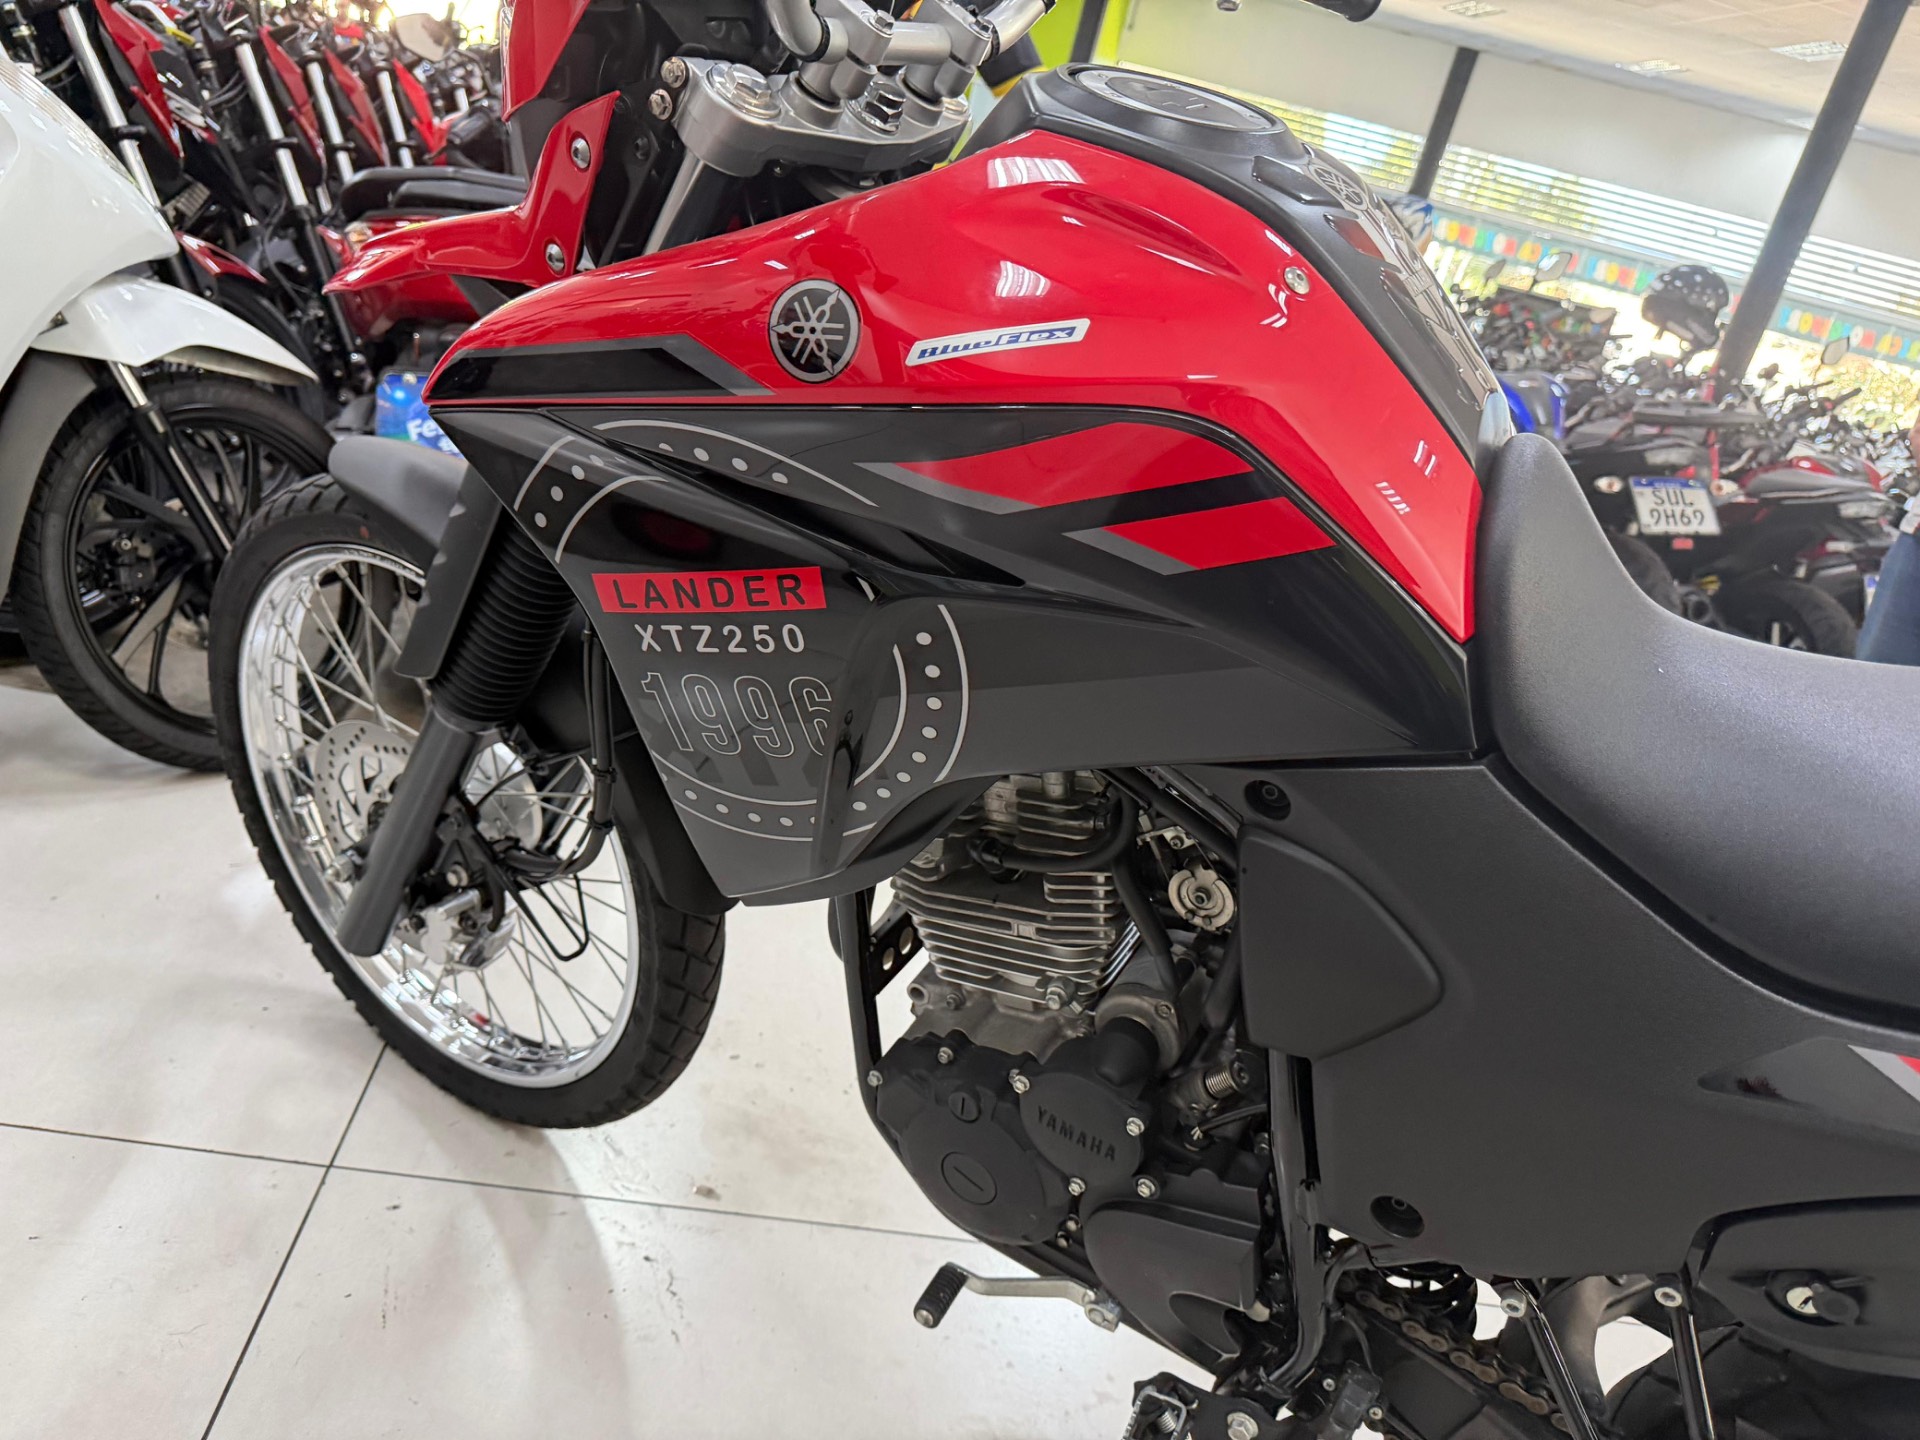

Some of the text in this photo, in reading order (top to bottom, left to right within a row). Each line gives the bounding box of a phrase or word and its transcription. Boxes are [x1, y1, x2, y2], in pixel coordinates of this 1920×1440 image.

[916, 325, 1077, 360] BlueFlex
[1652, 487, 1695, 507] SUL
[1650, 507, 1705, 527] 9H69
[612, 573, 806, 609] LANDER
[633, 623, 805, 653] XTZ250
[640, 671, 833, 758] 1996
[1037, 1105, 1116, 1161] YAMAHA
